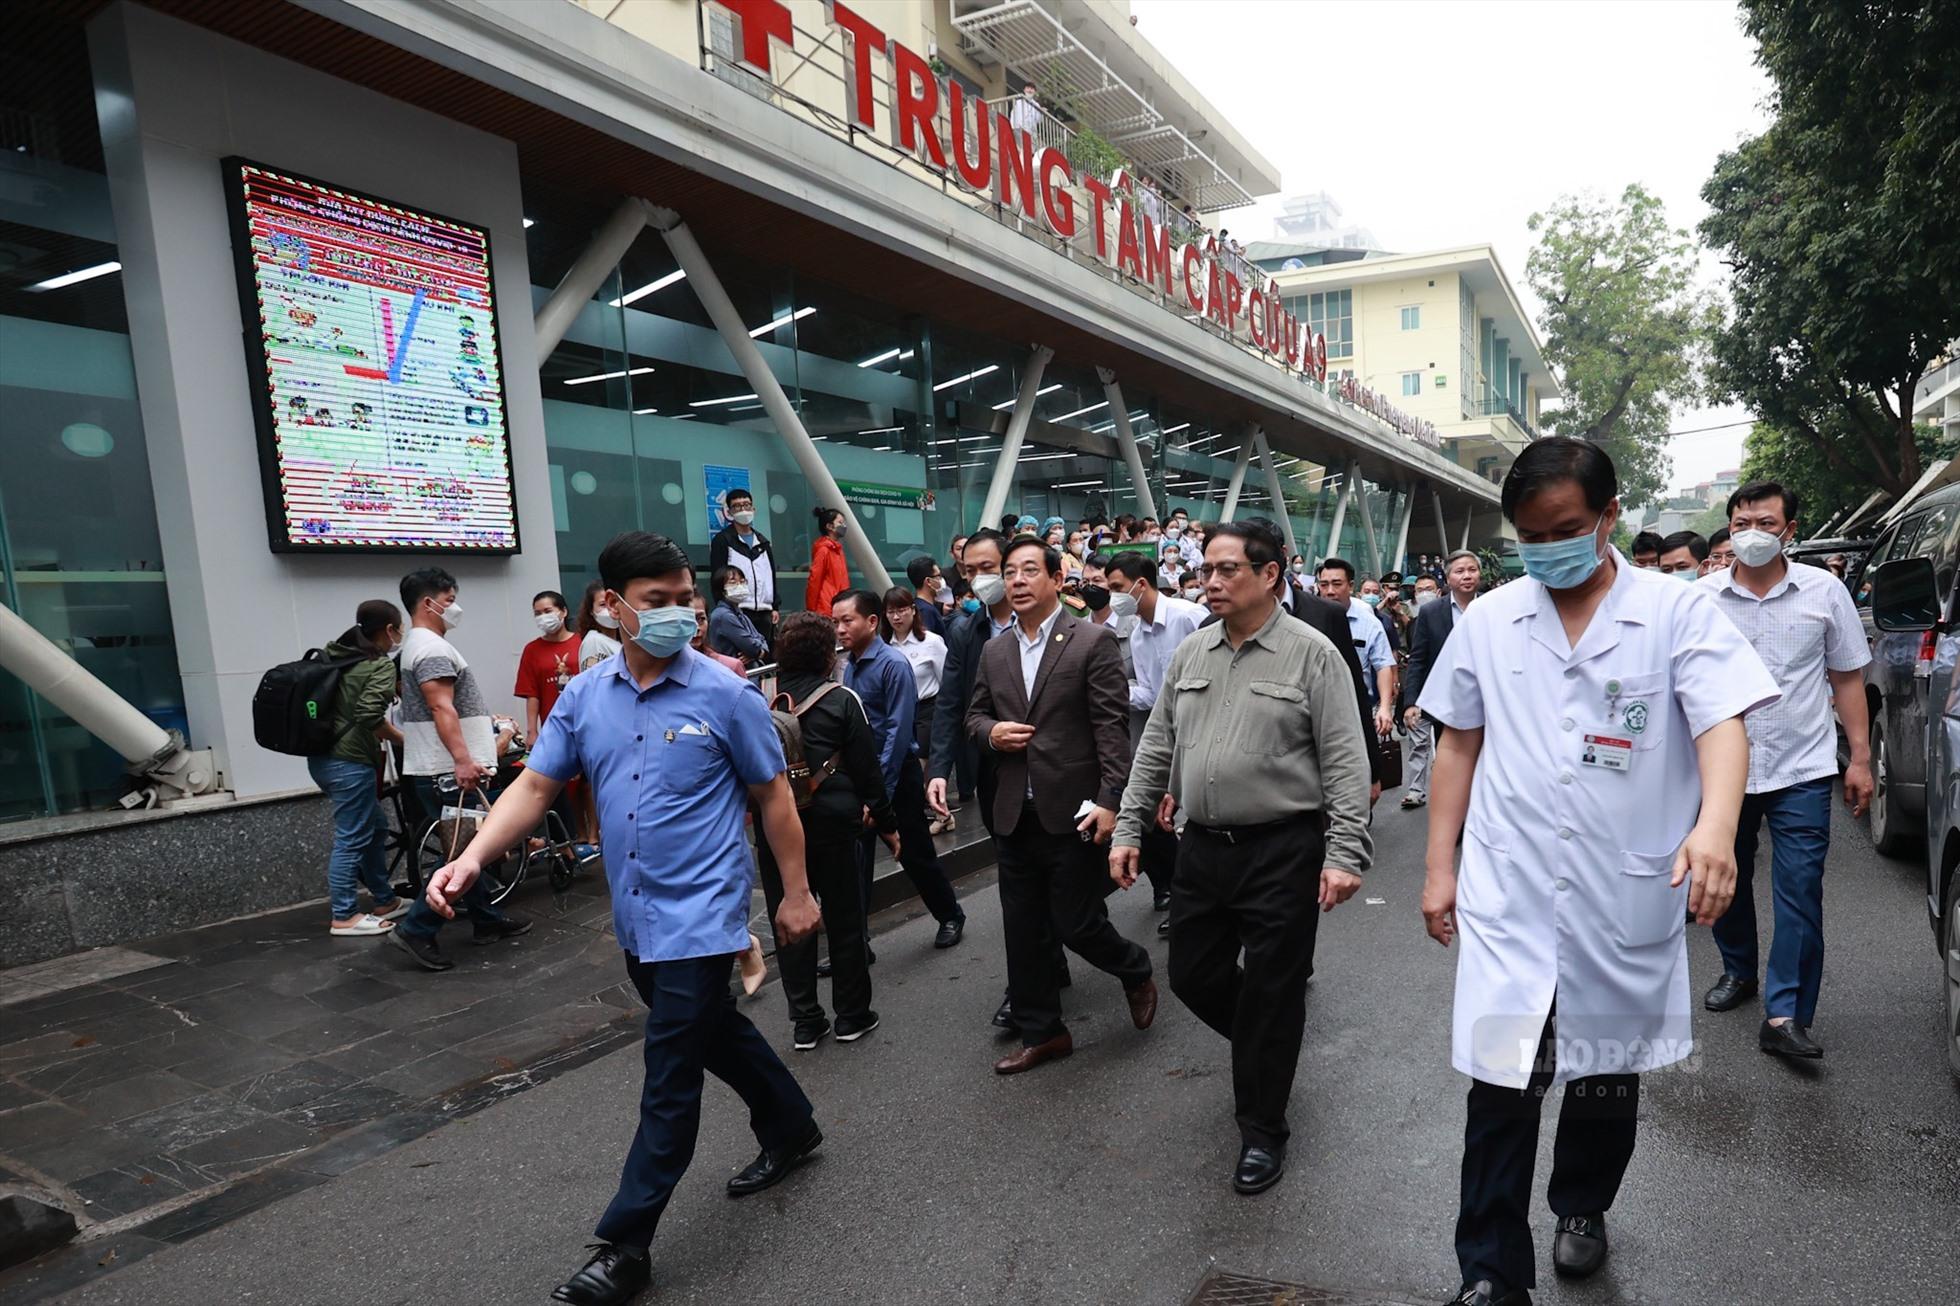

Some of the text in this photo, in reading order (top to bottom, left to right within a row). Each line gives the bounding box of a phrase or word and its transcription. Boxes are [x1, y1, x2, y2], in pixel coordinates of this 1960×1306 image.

[831, 0, 1075, 238] TRUNG
[1084, 169, 1174, 296] TÂM
[1300, 323, 1328, 384] A9
